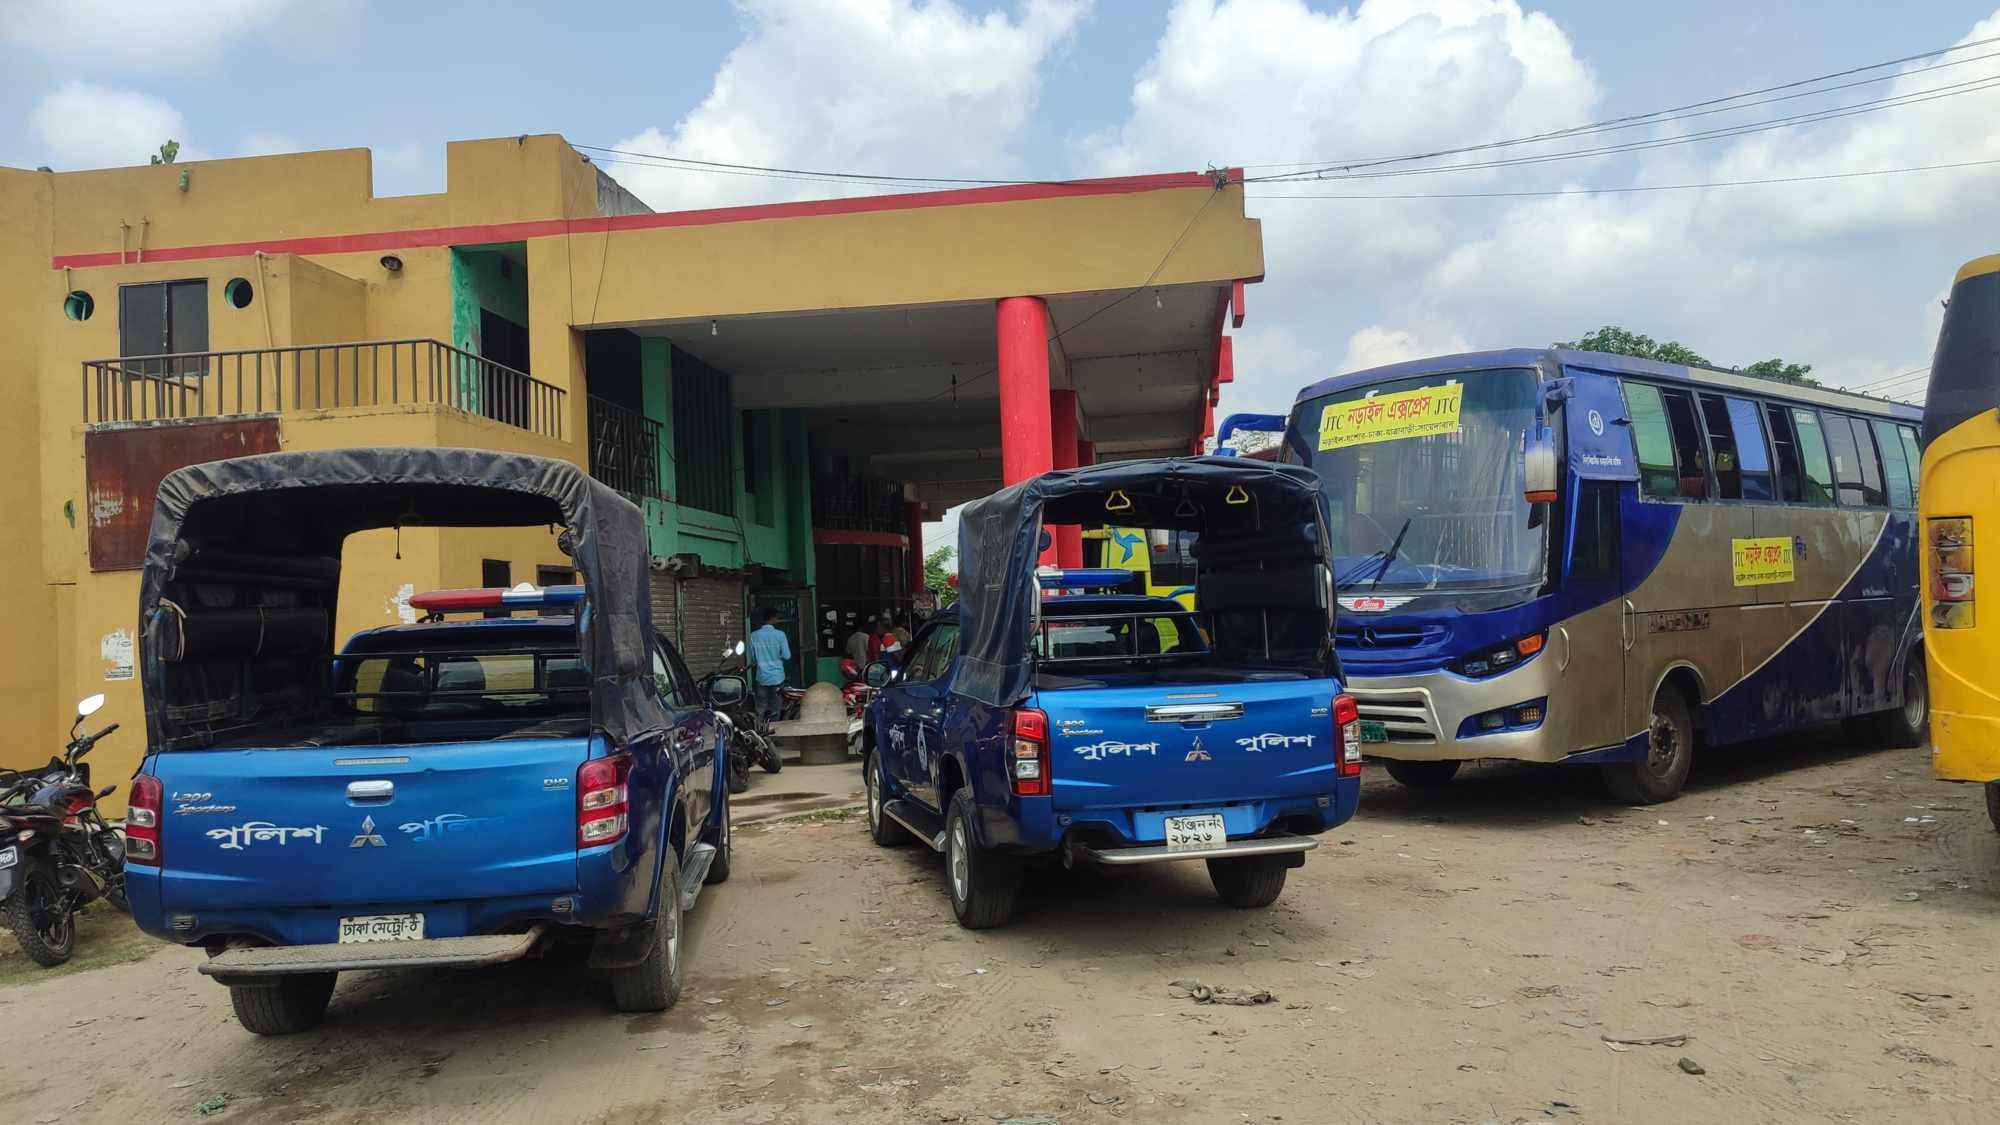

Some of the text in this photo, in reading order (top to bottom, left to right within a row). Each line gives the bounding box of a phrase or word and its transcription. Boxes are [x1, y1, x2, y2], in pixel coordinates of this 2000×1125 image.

[1324, 395, 1459, 432] JTC নড়াইল এক্সপ্রেস JTC
[1073, 740, 1160, 762] পুলিশ
[1235, 732, 1316, 753] পুলিশ
[206, 821, 329, 851] পুলিশ
[343, 921, 370, 937] ঢাকা
